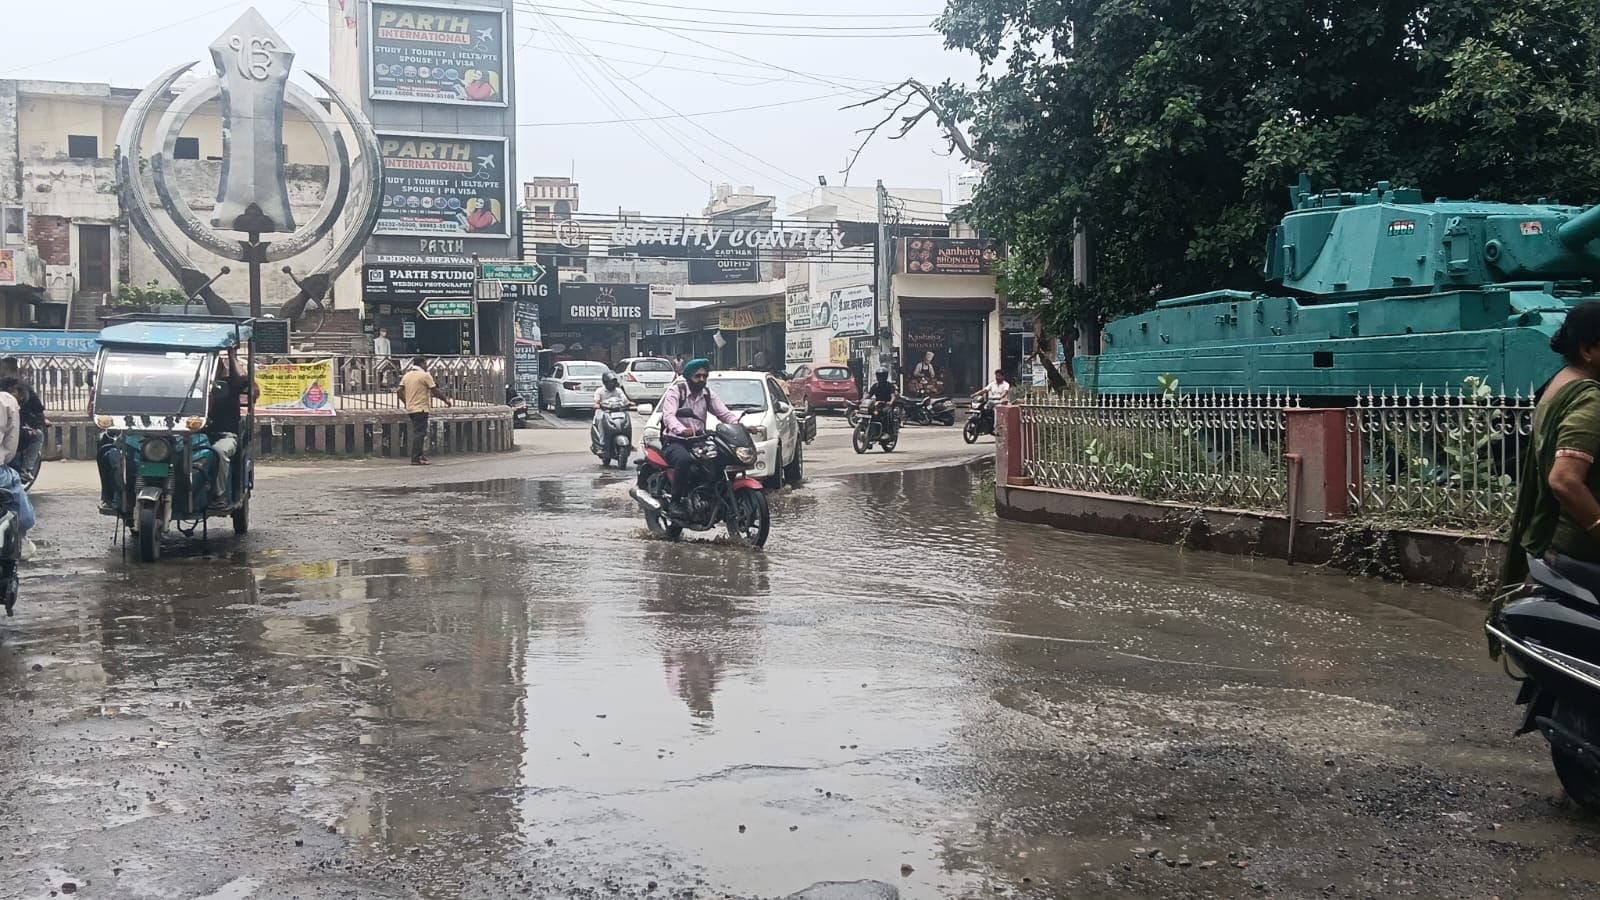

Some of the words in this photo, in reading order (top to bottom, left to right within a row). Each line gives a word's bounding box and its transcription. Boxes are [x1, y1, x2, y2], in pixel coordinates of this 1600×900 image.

[379, 10, 470, 33] PARTH
[381, 29, 467, 43] INTERNATIONAL
[374, 46, 401, 54] STUDY
[411, 48, 447, 56] TOURIST
[459, 52, 498, 61] IELTS/PTE
[400, 56, 432, 64] SPOUSE
[442, 58, 453, 66] PR
[456, 59, 474, 67] VISA
[383, 140, 471, 160] PARTH
[384, 158, 470, 171] INTERNATIONAL
[414, 178, 449, 186] TOURIST
[461, 180, 499, 188] IELTS/PTE
[402, 186, 435, 194] SPOUSE
[420, 239, 464, 253] PARTH
[426, 256, 474, 265] SHERWAN
[389, 270, 429, 280] PARTH
[431, 270, 475, 280] STUDIO
[570, 305, 609, 318] CRISPY
[612, 306, 642, 318] BITES
